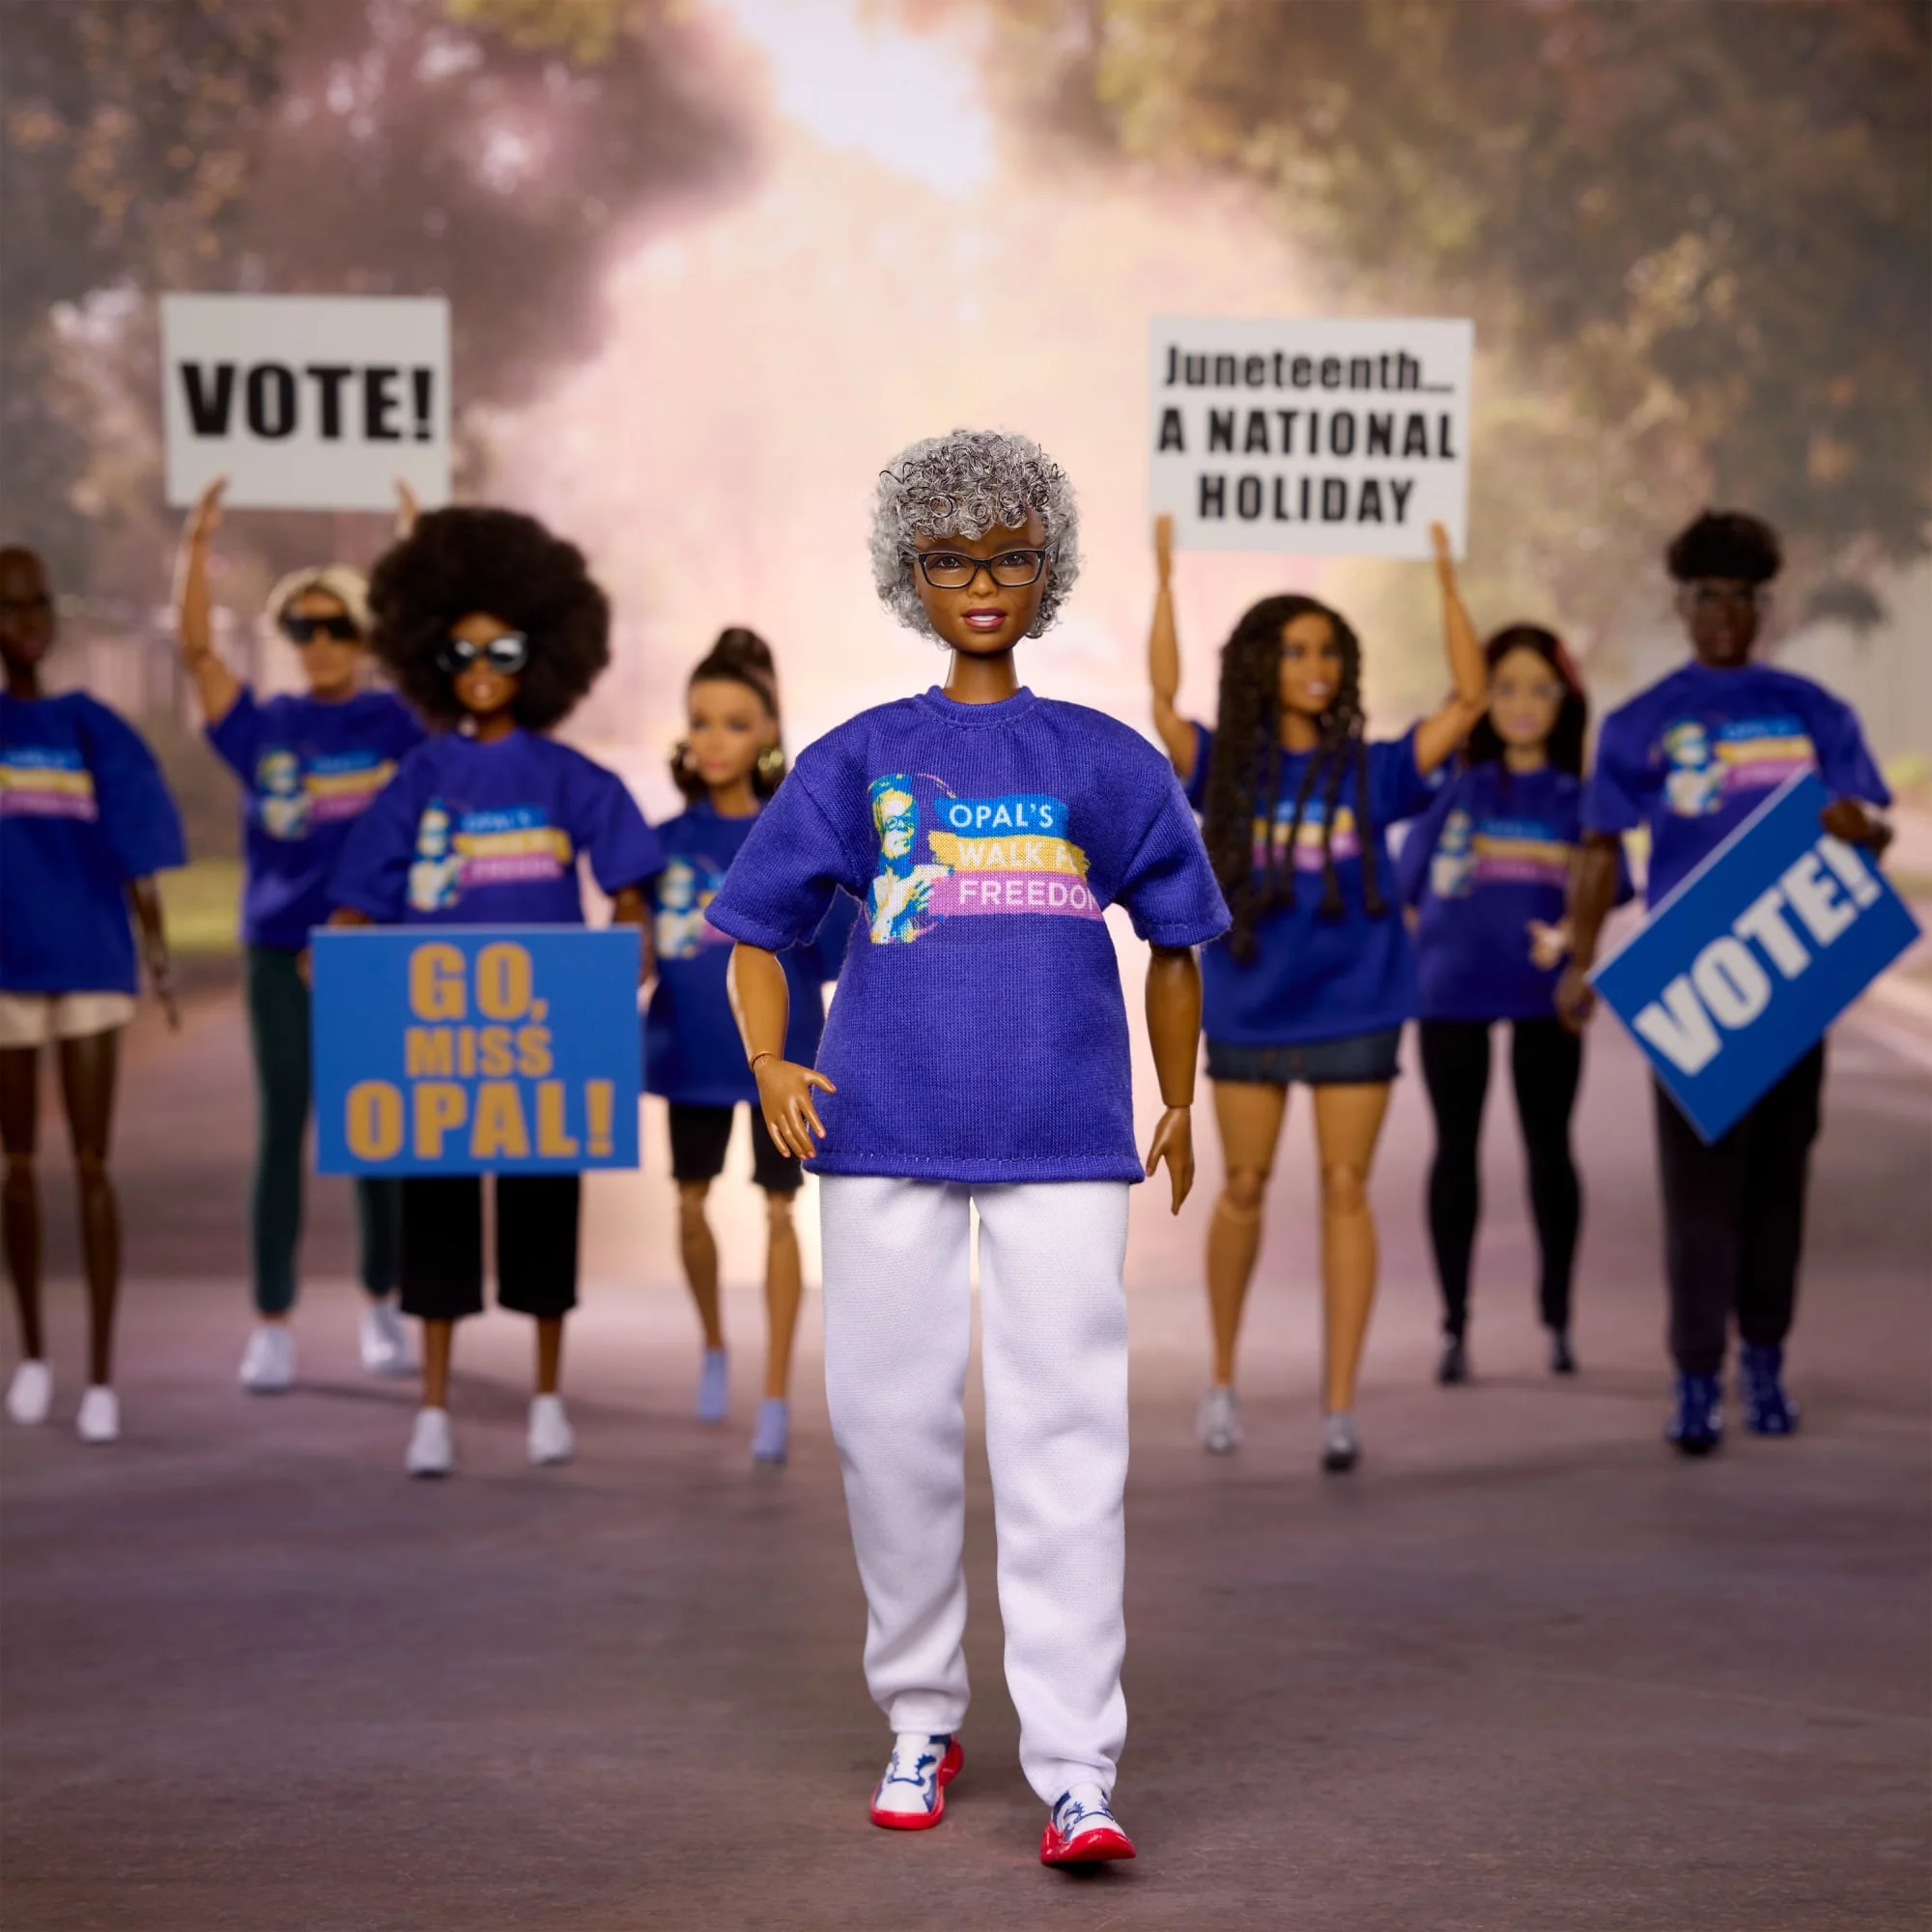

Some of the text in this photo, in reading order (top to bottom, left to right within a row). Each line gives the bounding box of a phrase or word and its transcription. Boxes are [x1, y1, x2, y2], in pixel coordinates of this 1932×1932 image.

[180, 360, 434, 442] VOTE!
[1157, 407, 1457, 460] A NATIONAL
[1198, 472, 1416, 525] HOLIDAY
[949, 803, 1054, 830] OPAL'S
[957, 842, 1043, 868] WALK
[409, 942, 549, 1022] GO,
[1633, 834, 1881, 1077] VOTE!
[405, 1026, 553, 1078] MISS
[345, 1079, 614, 1161] OPAL!
